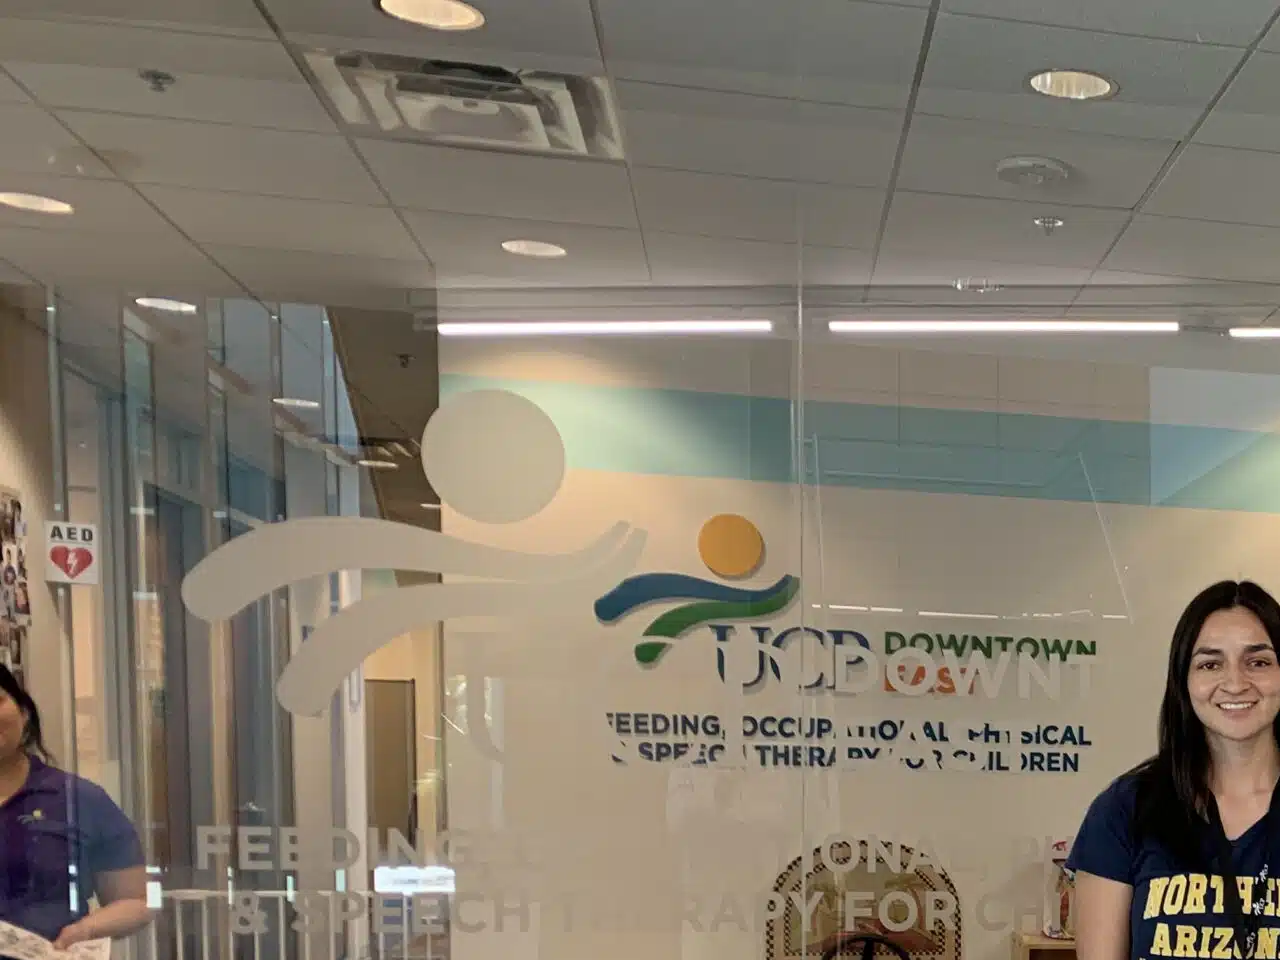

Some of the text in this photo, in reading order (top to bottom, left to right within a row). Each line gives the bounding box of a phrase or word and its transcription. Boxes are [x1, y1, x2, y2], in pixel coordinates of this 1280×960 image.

[50, 525, 93, 542] AED
[884, 632, 1097, 662] DOWNTOWN
[842, 891, 958, 934] FOR
